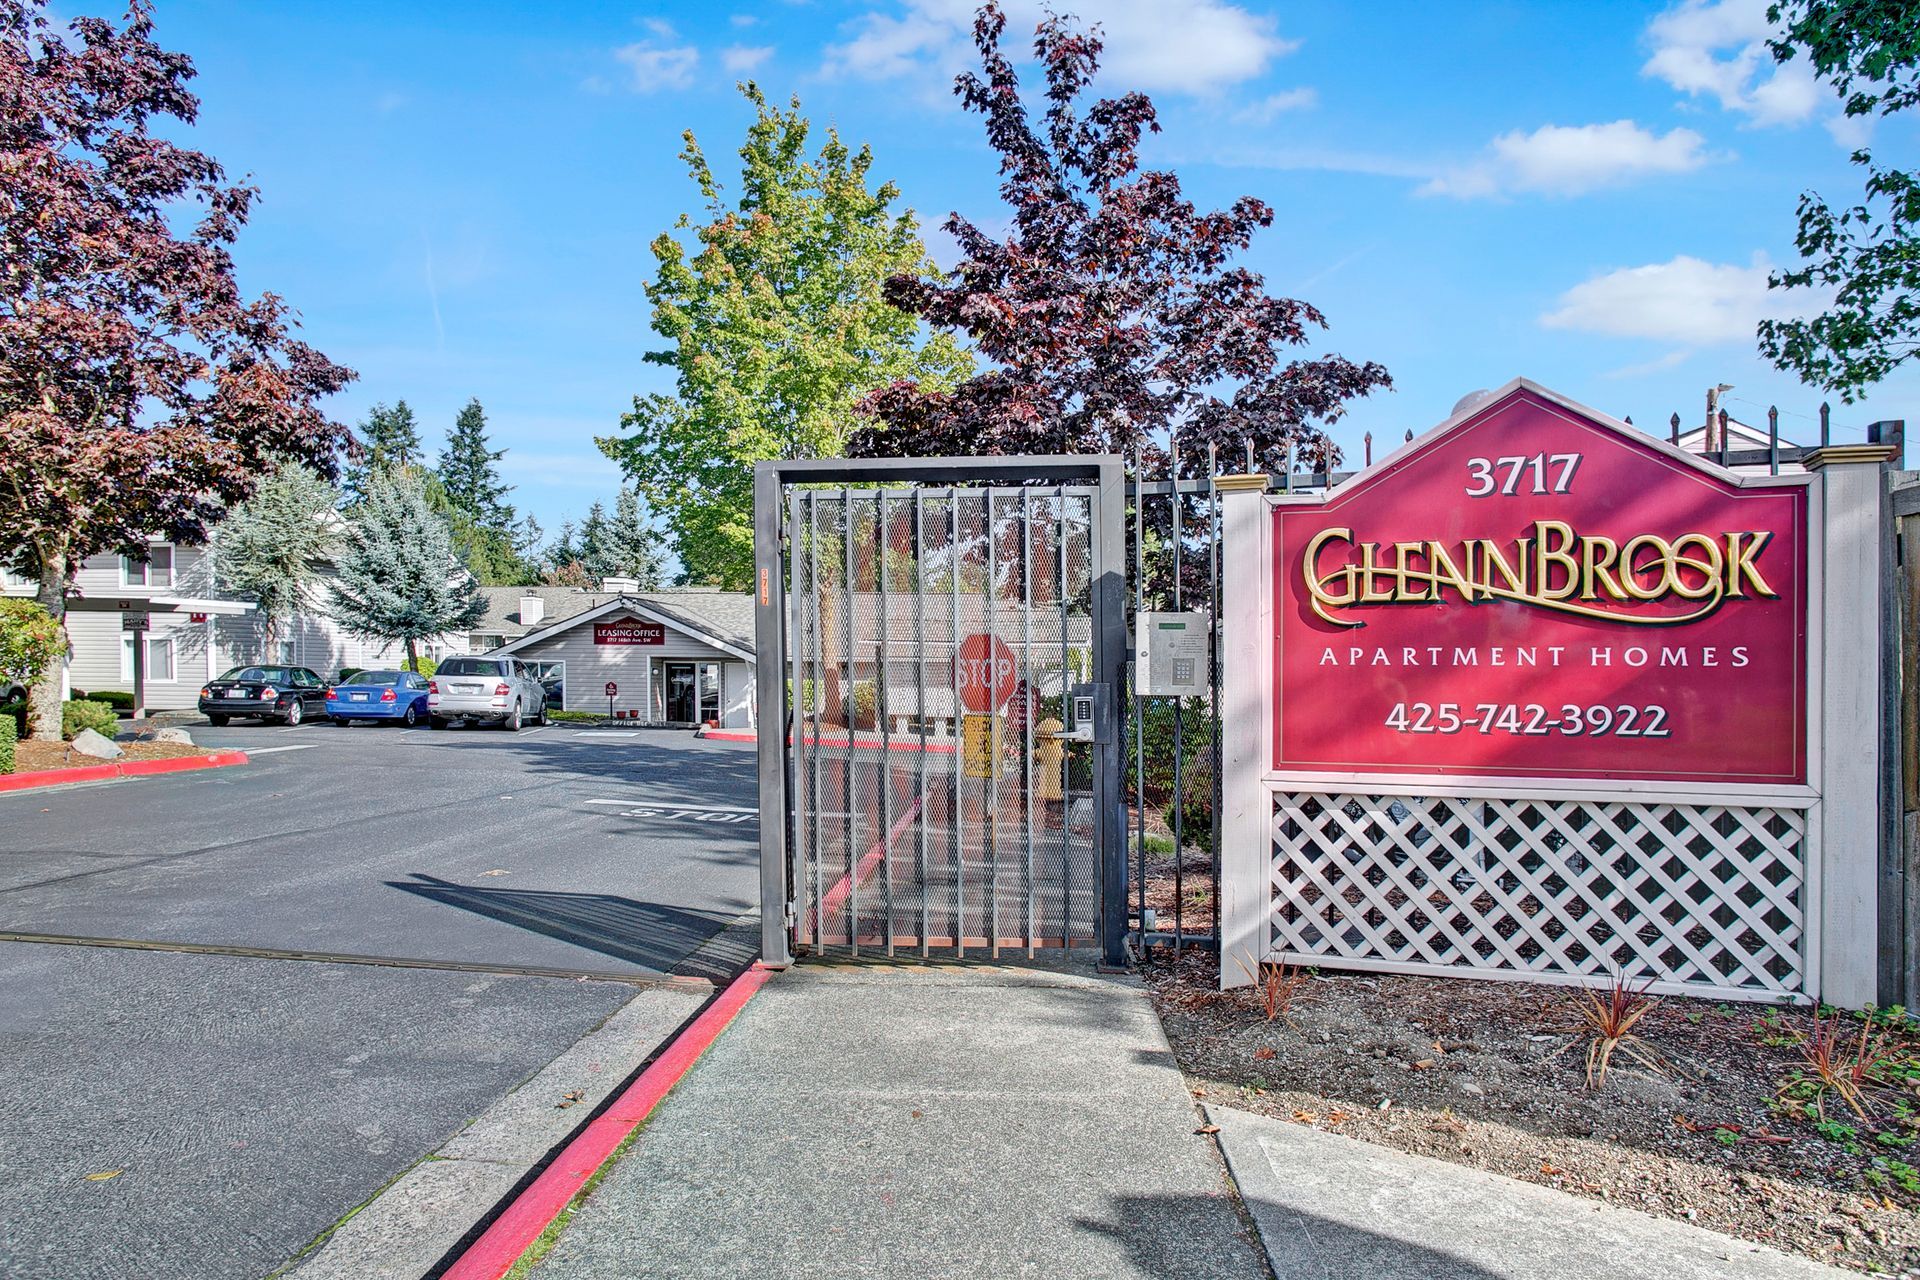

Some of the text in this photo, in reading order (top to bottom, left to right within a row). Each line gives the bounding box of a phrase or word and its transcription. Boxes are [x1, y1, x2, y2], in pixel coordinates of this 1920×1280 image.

[1464, 451, 1583, 497] 3717
[597, 629, 660, 637] LEASING OFFICE
[1319, 646, 1751, 668] APARTMENT HOMES
[956, 658, 1012, 688] STOP
[1385, 702, 1672, 738] 425-742-3922
